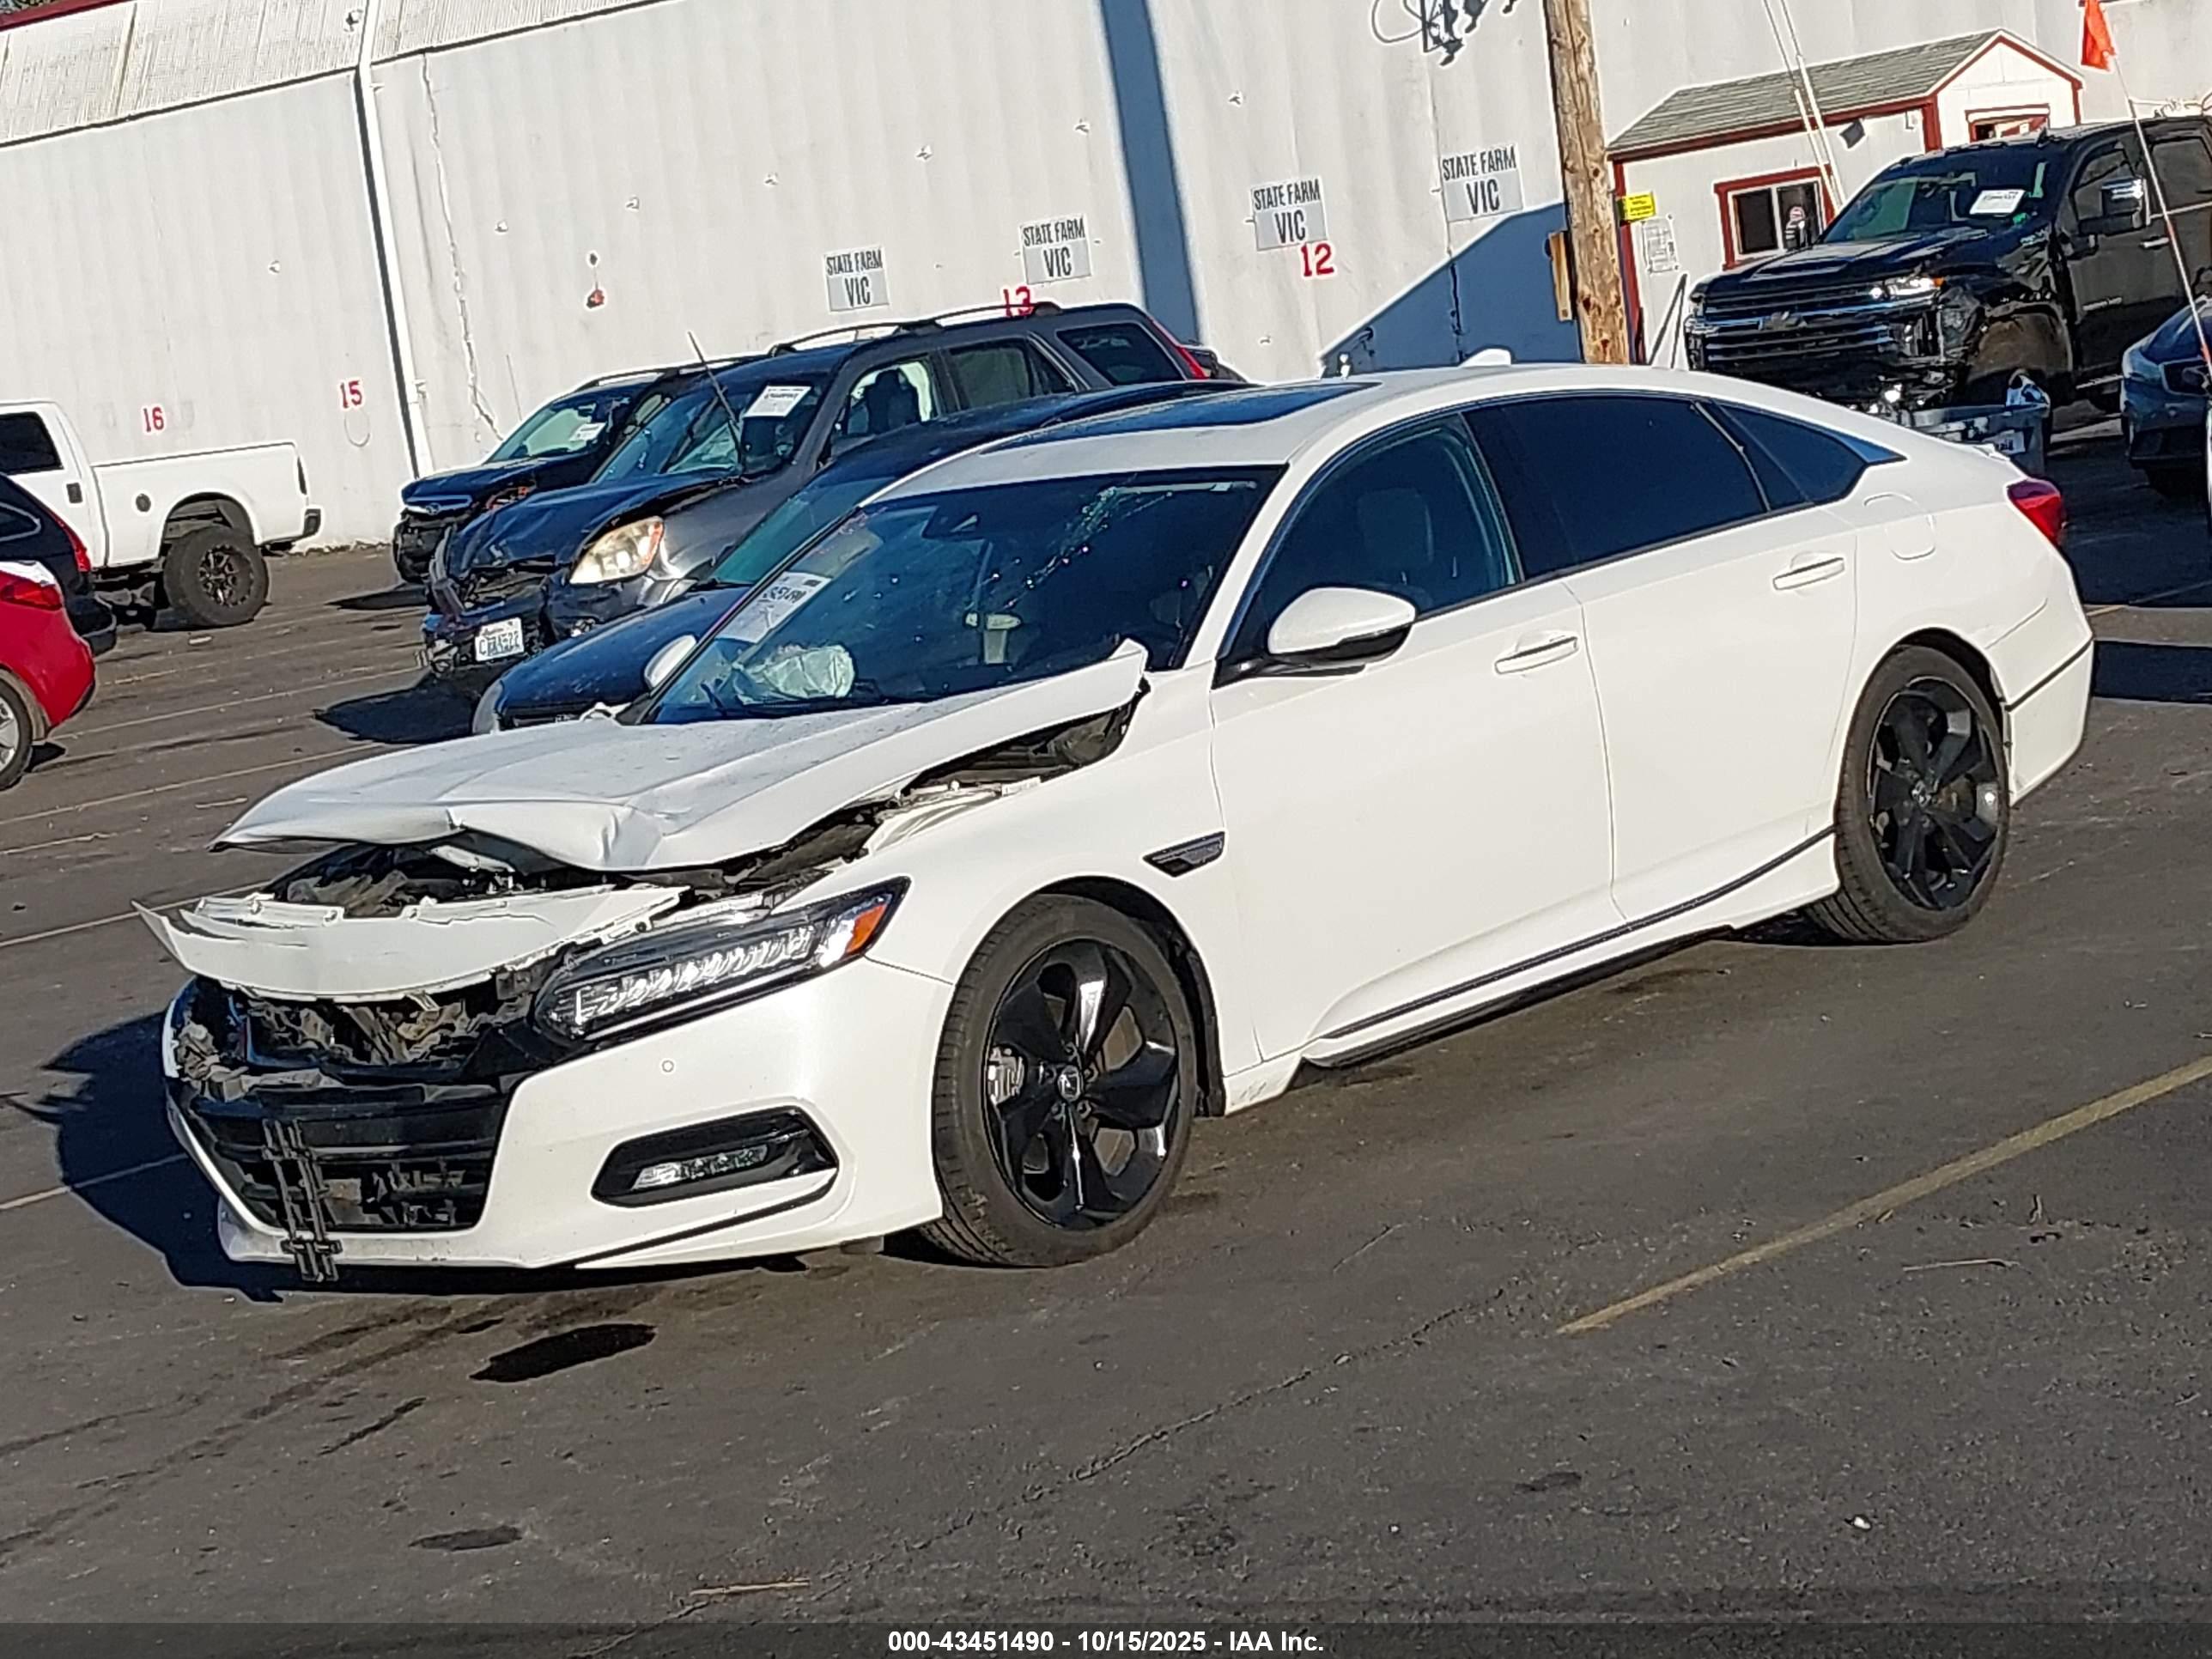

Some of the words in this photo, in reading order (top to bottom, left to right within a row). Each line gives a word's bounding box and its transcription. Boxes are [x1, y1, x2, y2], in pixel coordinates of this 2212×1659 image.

[1443, 153, 1478, 181] STATE
[1480, 146, 1516, 174] FARM
[1254, 185, 1286, 210] STATE
[1287, 179, 1321, 204] FARM
[1466, 179, 1500, 215] VIC
[1023, 223, 1054, 247] STATE
[1054, 217, 1085, 242] FARM
[1274, 210, 1306, 244] VIC
[826, 253, 854, 276] STATE
[854, 249, 883, 272] FARM
[1043, 246, 1072, 277] VIC
[1301, 242, 1334, 277] 12
[844, 276, 870, 307] VIC
[340, 380, 362, 409] 15
[143, 406, 165, 433] 16
